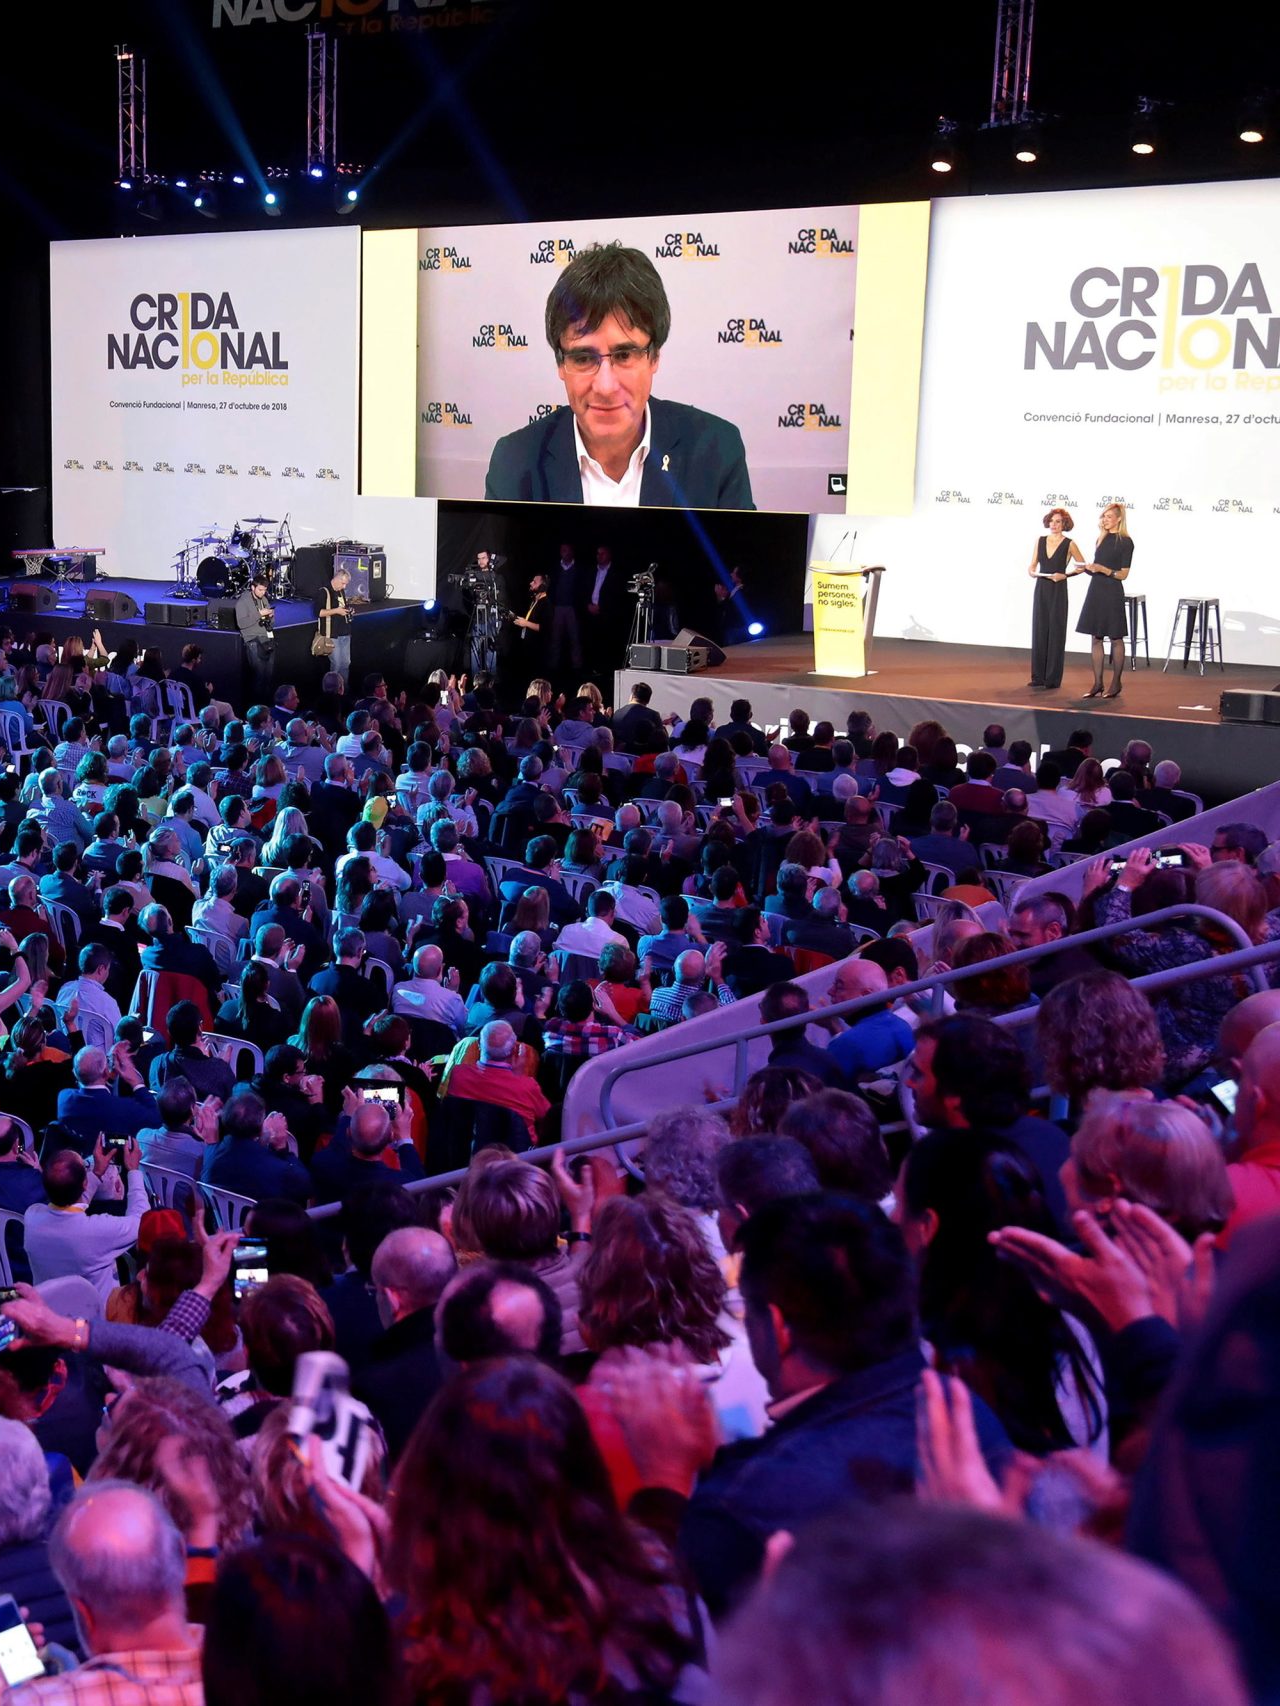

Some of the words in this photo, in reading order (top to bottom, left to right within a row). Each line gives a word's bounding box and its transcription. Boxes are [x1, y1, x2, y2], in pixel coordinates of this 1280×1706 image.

[389, 6, 500, 34] Repúblic
[181, 374, 203, 388] per
[206, 371, 219, 385] la
[222, 371, 288, 388] República
[1158, 377, 1199, 395] per
[1205, 372, 1227, 391] la
[1234, 372, 1280, 394] Rep
[109, 400, 141, 409] Convenció
[143, 400, 181, 410] Fundacional
[187, 401, 219, 411] Manresa,
[219, 402, 228, 410] 27
[228, 401, 260, 411] d'octubre
[261, 402, 271, 411] de
[272, 402, 287, 411] 2018
[1023, 411, 1081, 423] Convenció
[1083, 412, 1154, 424] Fundacional
[1165, 414, 1222, 427] Manresa,
[1224, 414, 1240, 424] 27
[1242, 414, 1280, 425] d'octu
[817, 581, 849, 590] Sumem
[818, 590, 858, 600] persones,
[830, 600, 856, 608] sigles.
